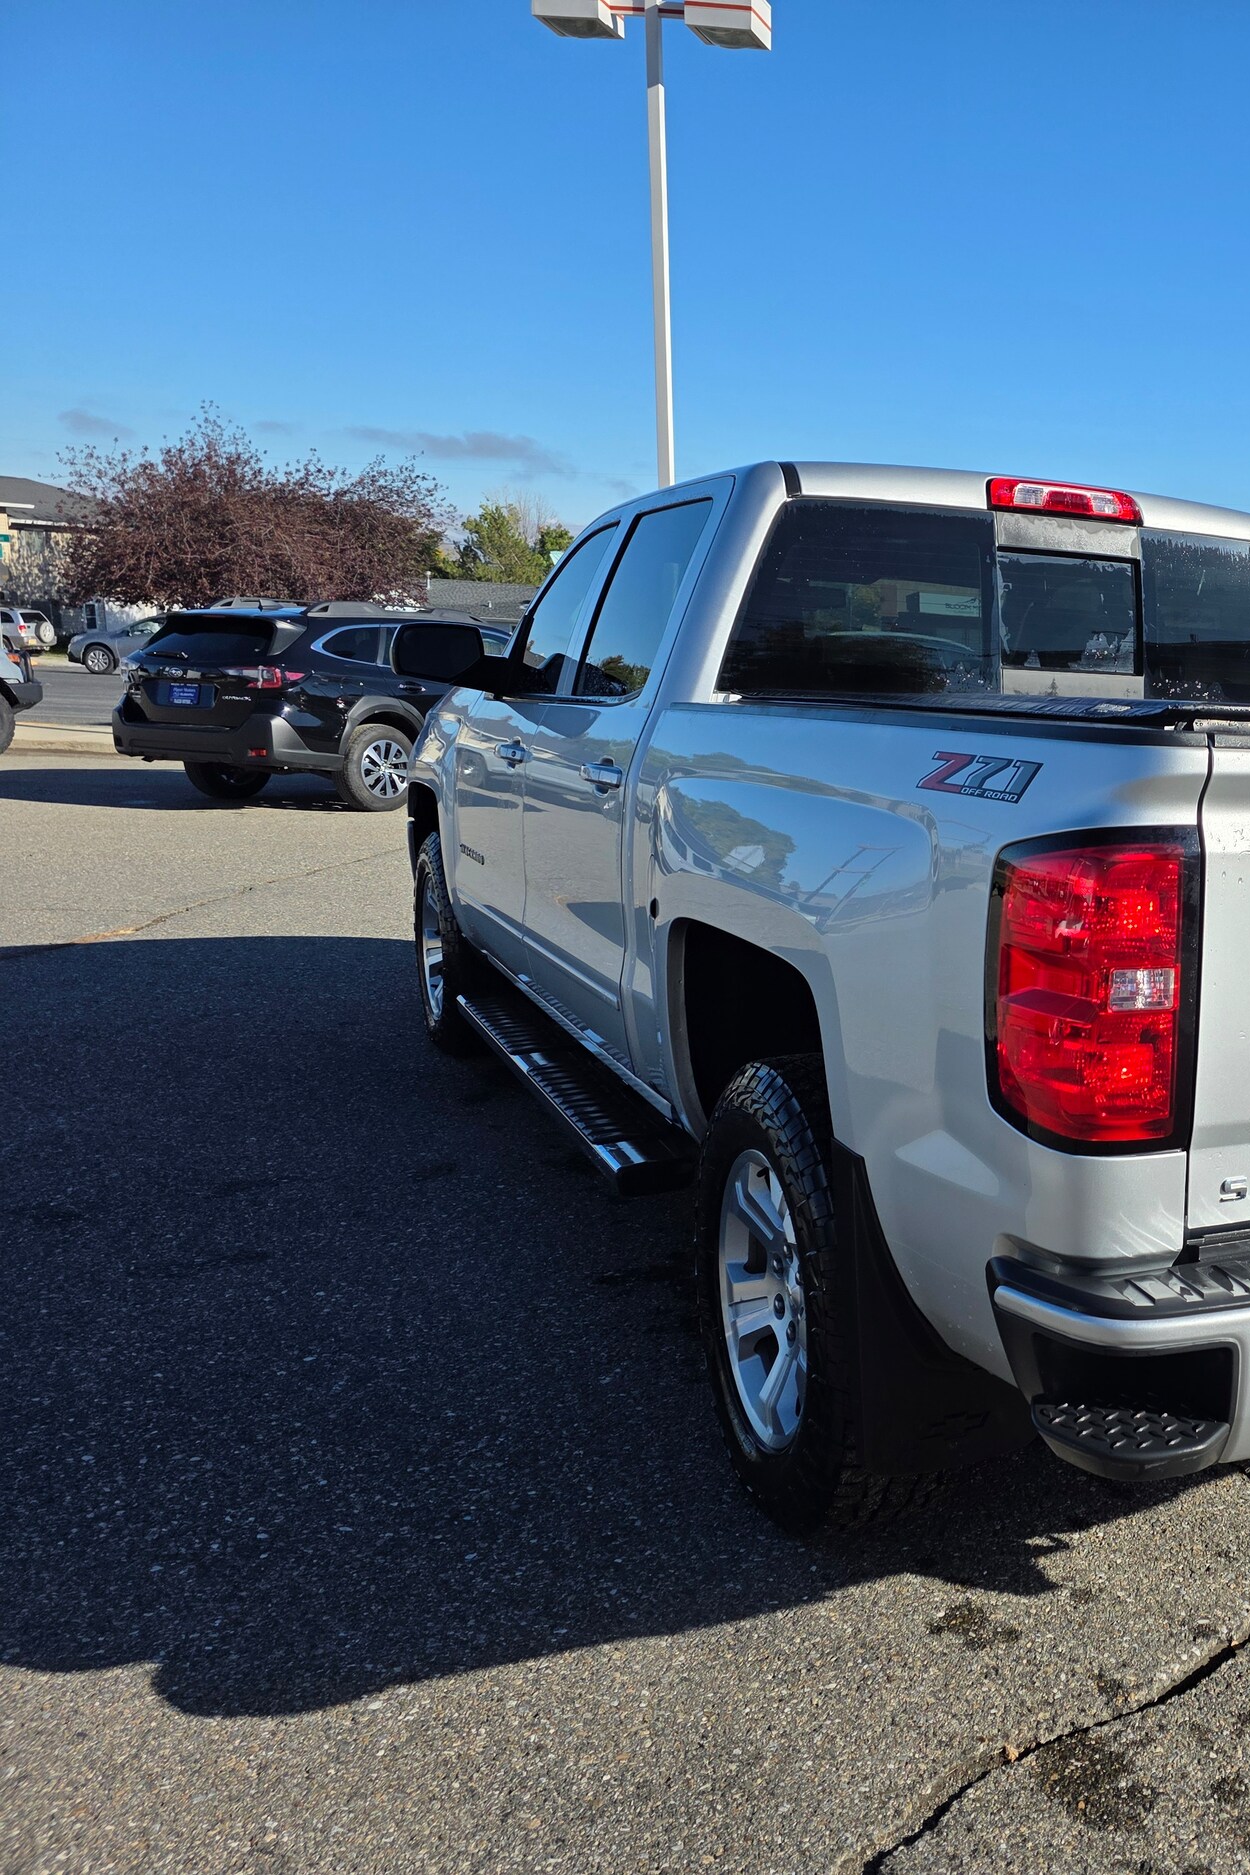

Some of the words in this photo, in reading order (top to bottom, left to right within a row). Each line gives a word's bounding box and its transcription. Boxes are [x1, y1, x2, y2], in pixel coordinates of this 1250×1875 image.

[916, 751, 1043, 797] Z71
[961, 787, 983, 796] OFF
[984, 791, 1018, 802] ROAD
